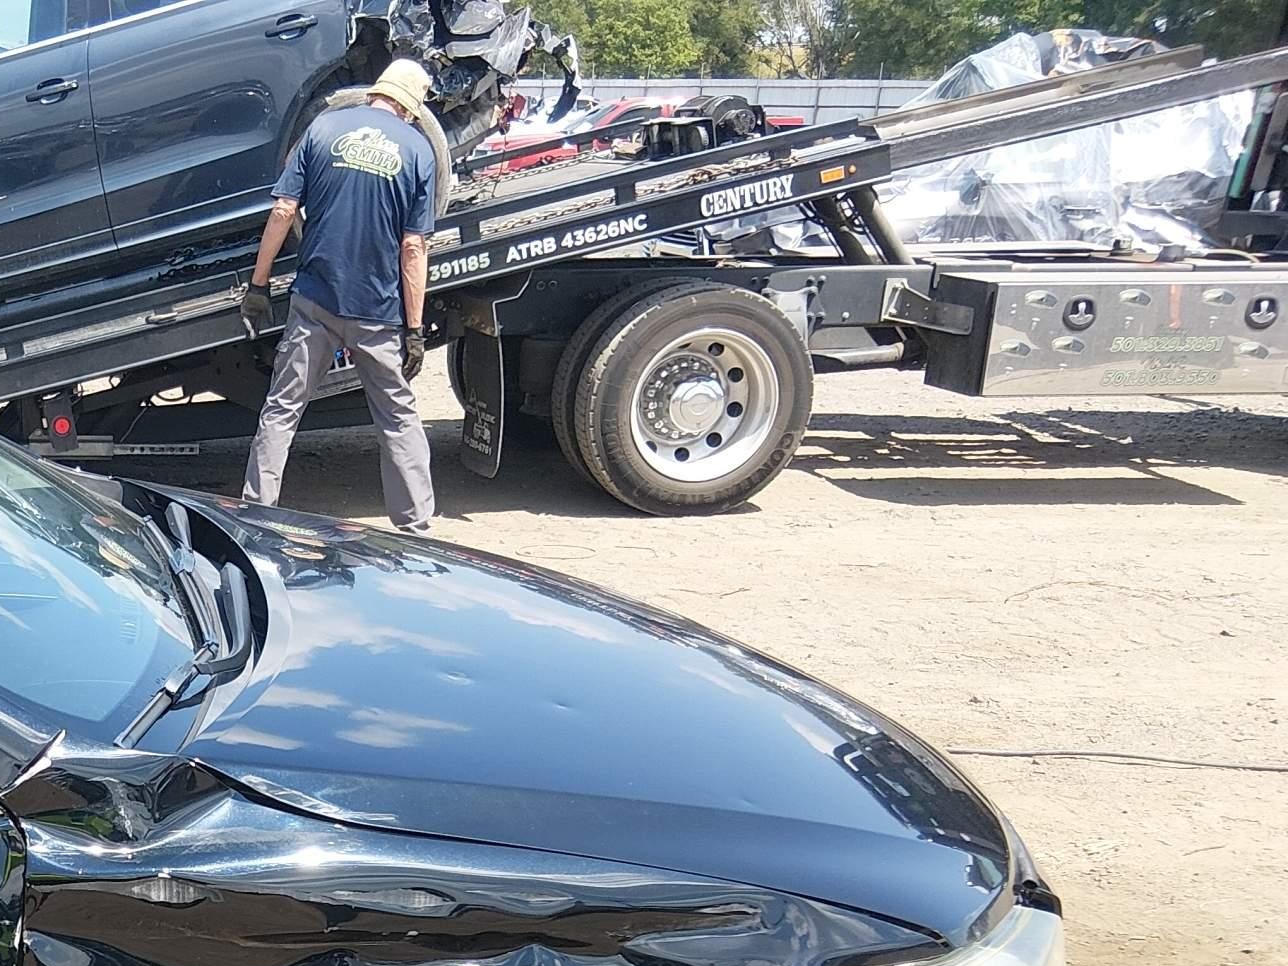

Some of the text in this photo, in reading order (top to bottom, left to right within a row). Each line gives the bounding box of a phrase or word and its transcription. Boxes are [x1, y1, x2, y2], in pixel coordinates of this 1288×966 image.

[347, 145, 397, 170] SMITH
[700, 174, 794, 217] CENTURY
[506, 237, 557, 263] ATRB
[561, 214, 648, 249] 43626NC
